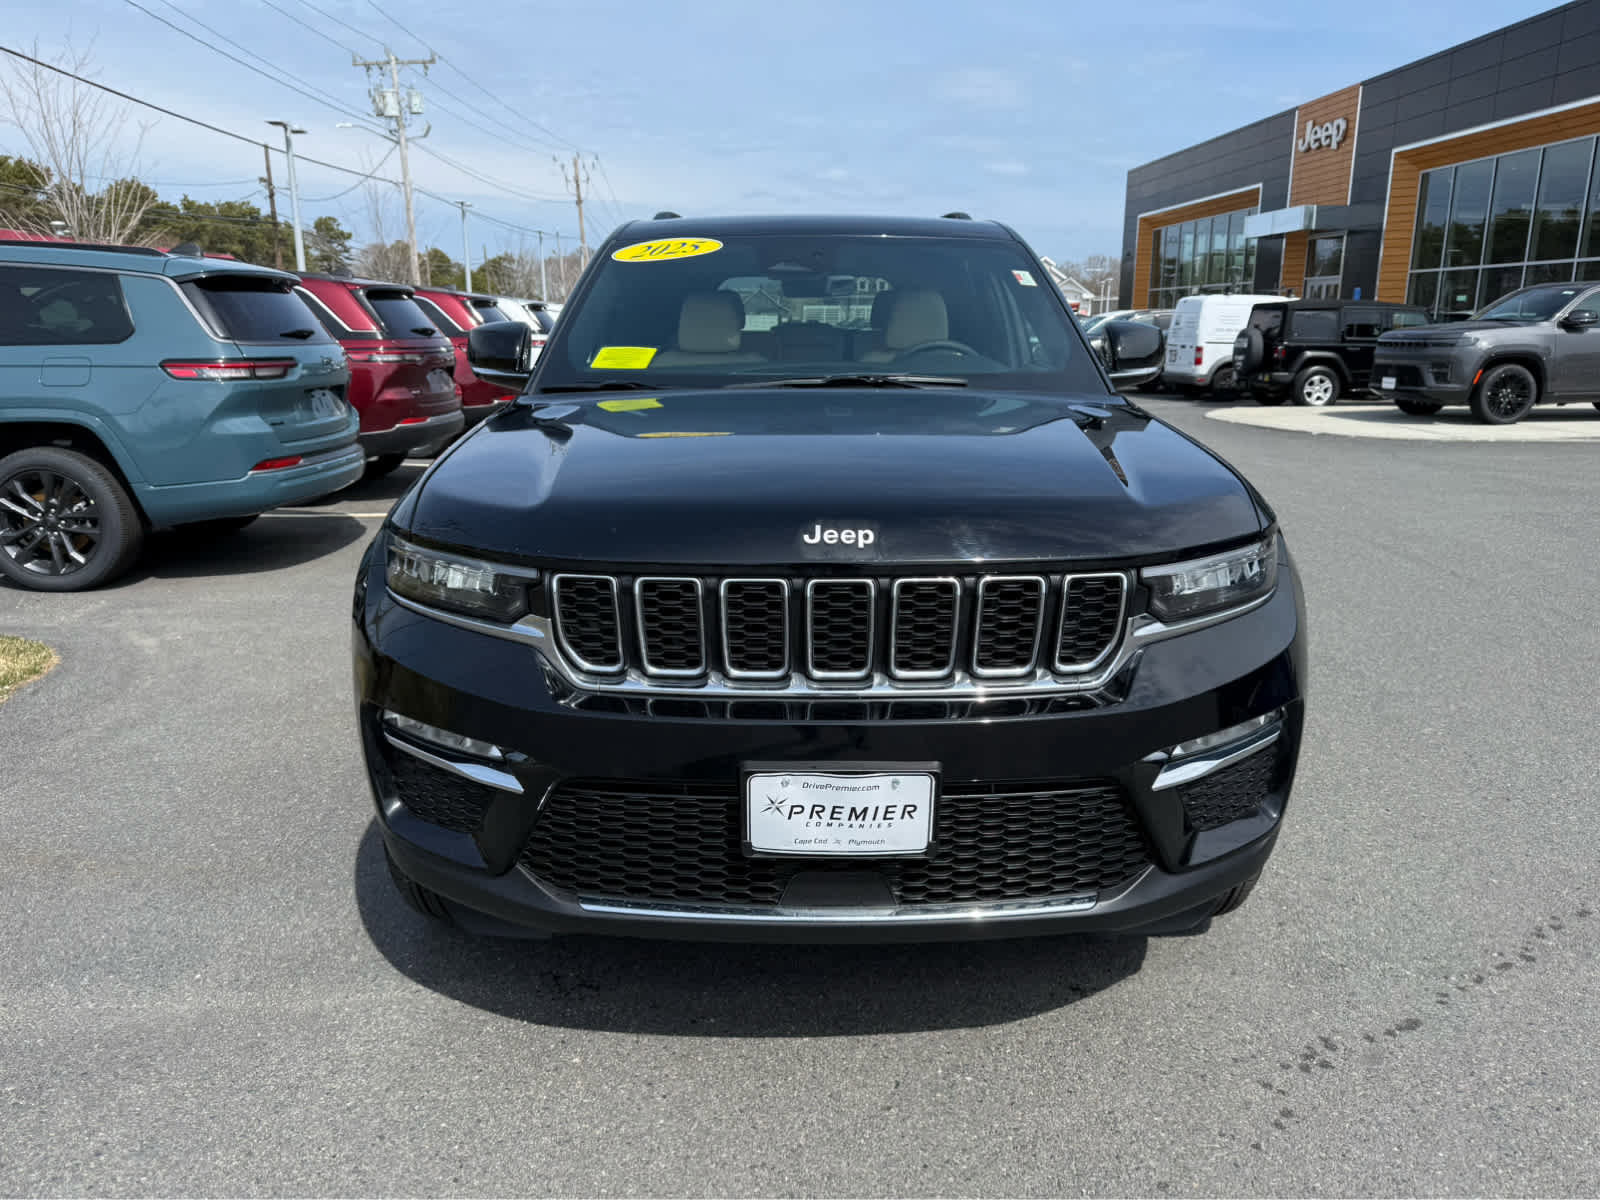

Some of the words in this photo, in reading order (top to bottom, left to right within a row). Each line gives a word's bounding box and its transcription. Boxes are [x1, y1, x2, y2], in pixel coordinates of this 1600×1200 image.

[1298, 118, 1347, 152] Jeep
[631, 241, 705, 258] 2025
[803, 525, 874, 548] Jeep
[802, 782, 880, 791] DrivePremier.com
[787, 804, 917, 821] PREMIER
[805, 821, 893, 829] COMPANIES
[848, 838, 885, 847] Plymouth
